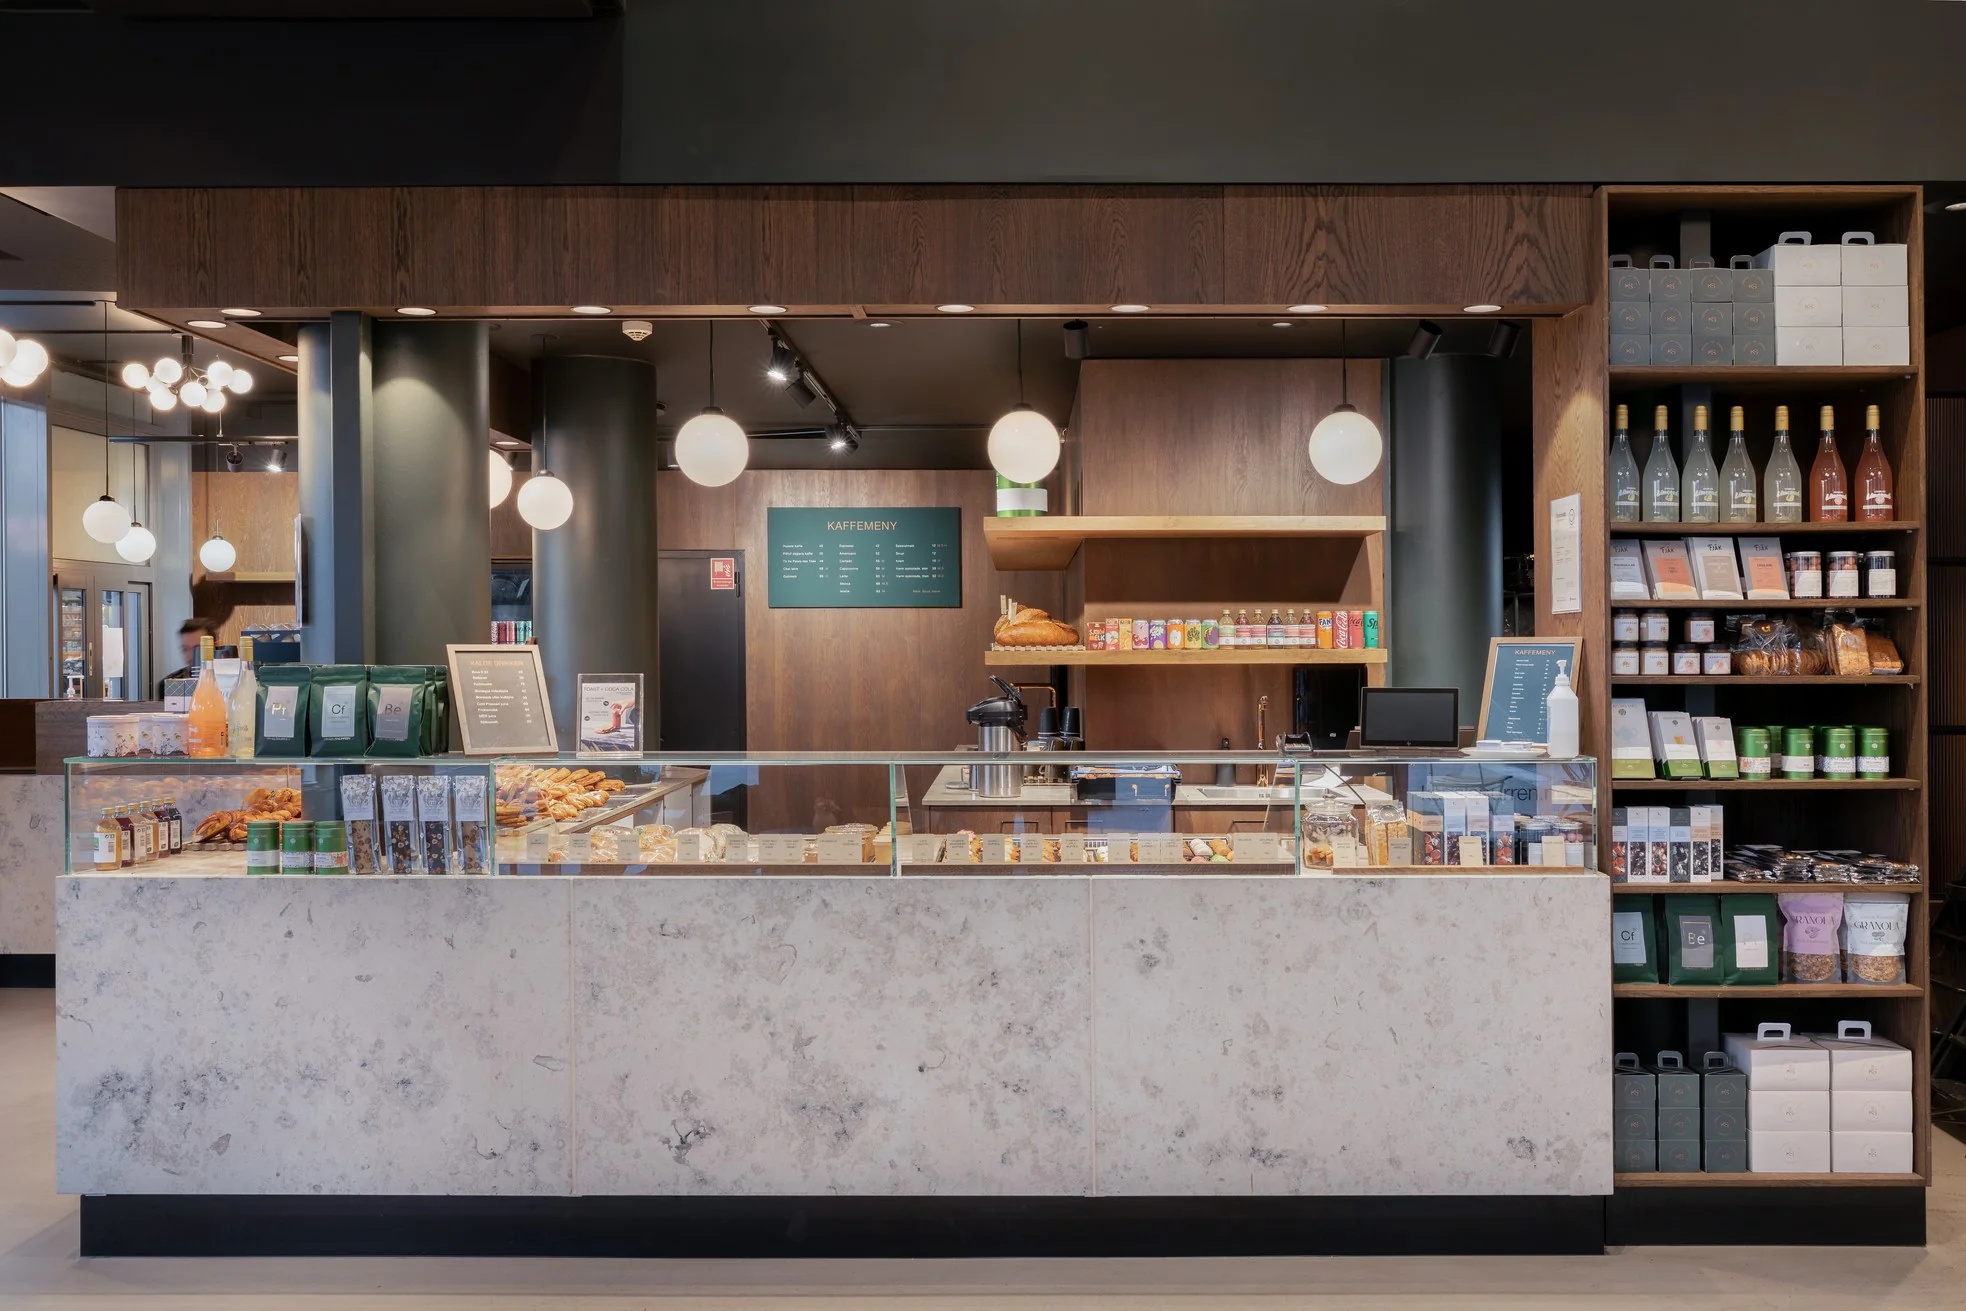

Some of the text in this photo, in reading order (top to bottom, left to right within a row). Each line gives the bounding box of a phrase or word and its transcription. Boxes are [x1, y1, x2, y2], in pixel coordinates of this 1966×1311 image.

[827, 521, 898, 531] KAFFEMENY
[1707, 543, 1722, 551] FJÅK
[331, 704, 345, 715] Cf
[384, 704, 402, 715] Be
[1853, 921, 1900, 930] GRANOLA
[1620, 930, 1635, 941] Cf
